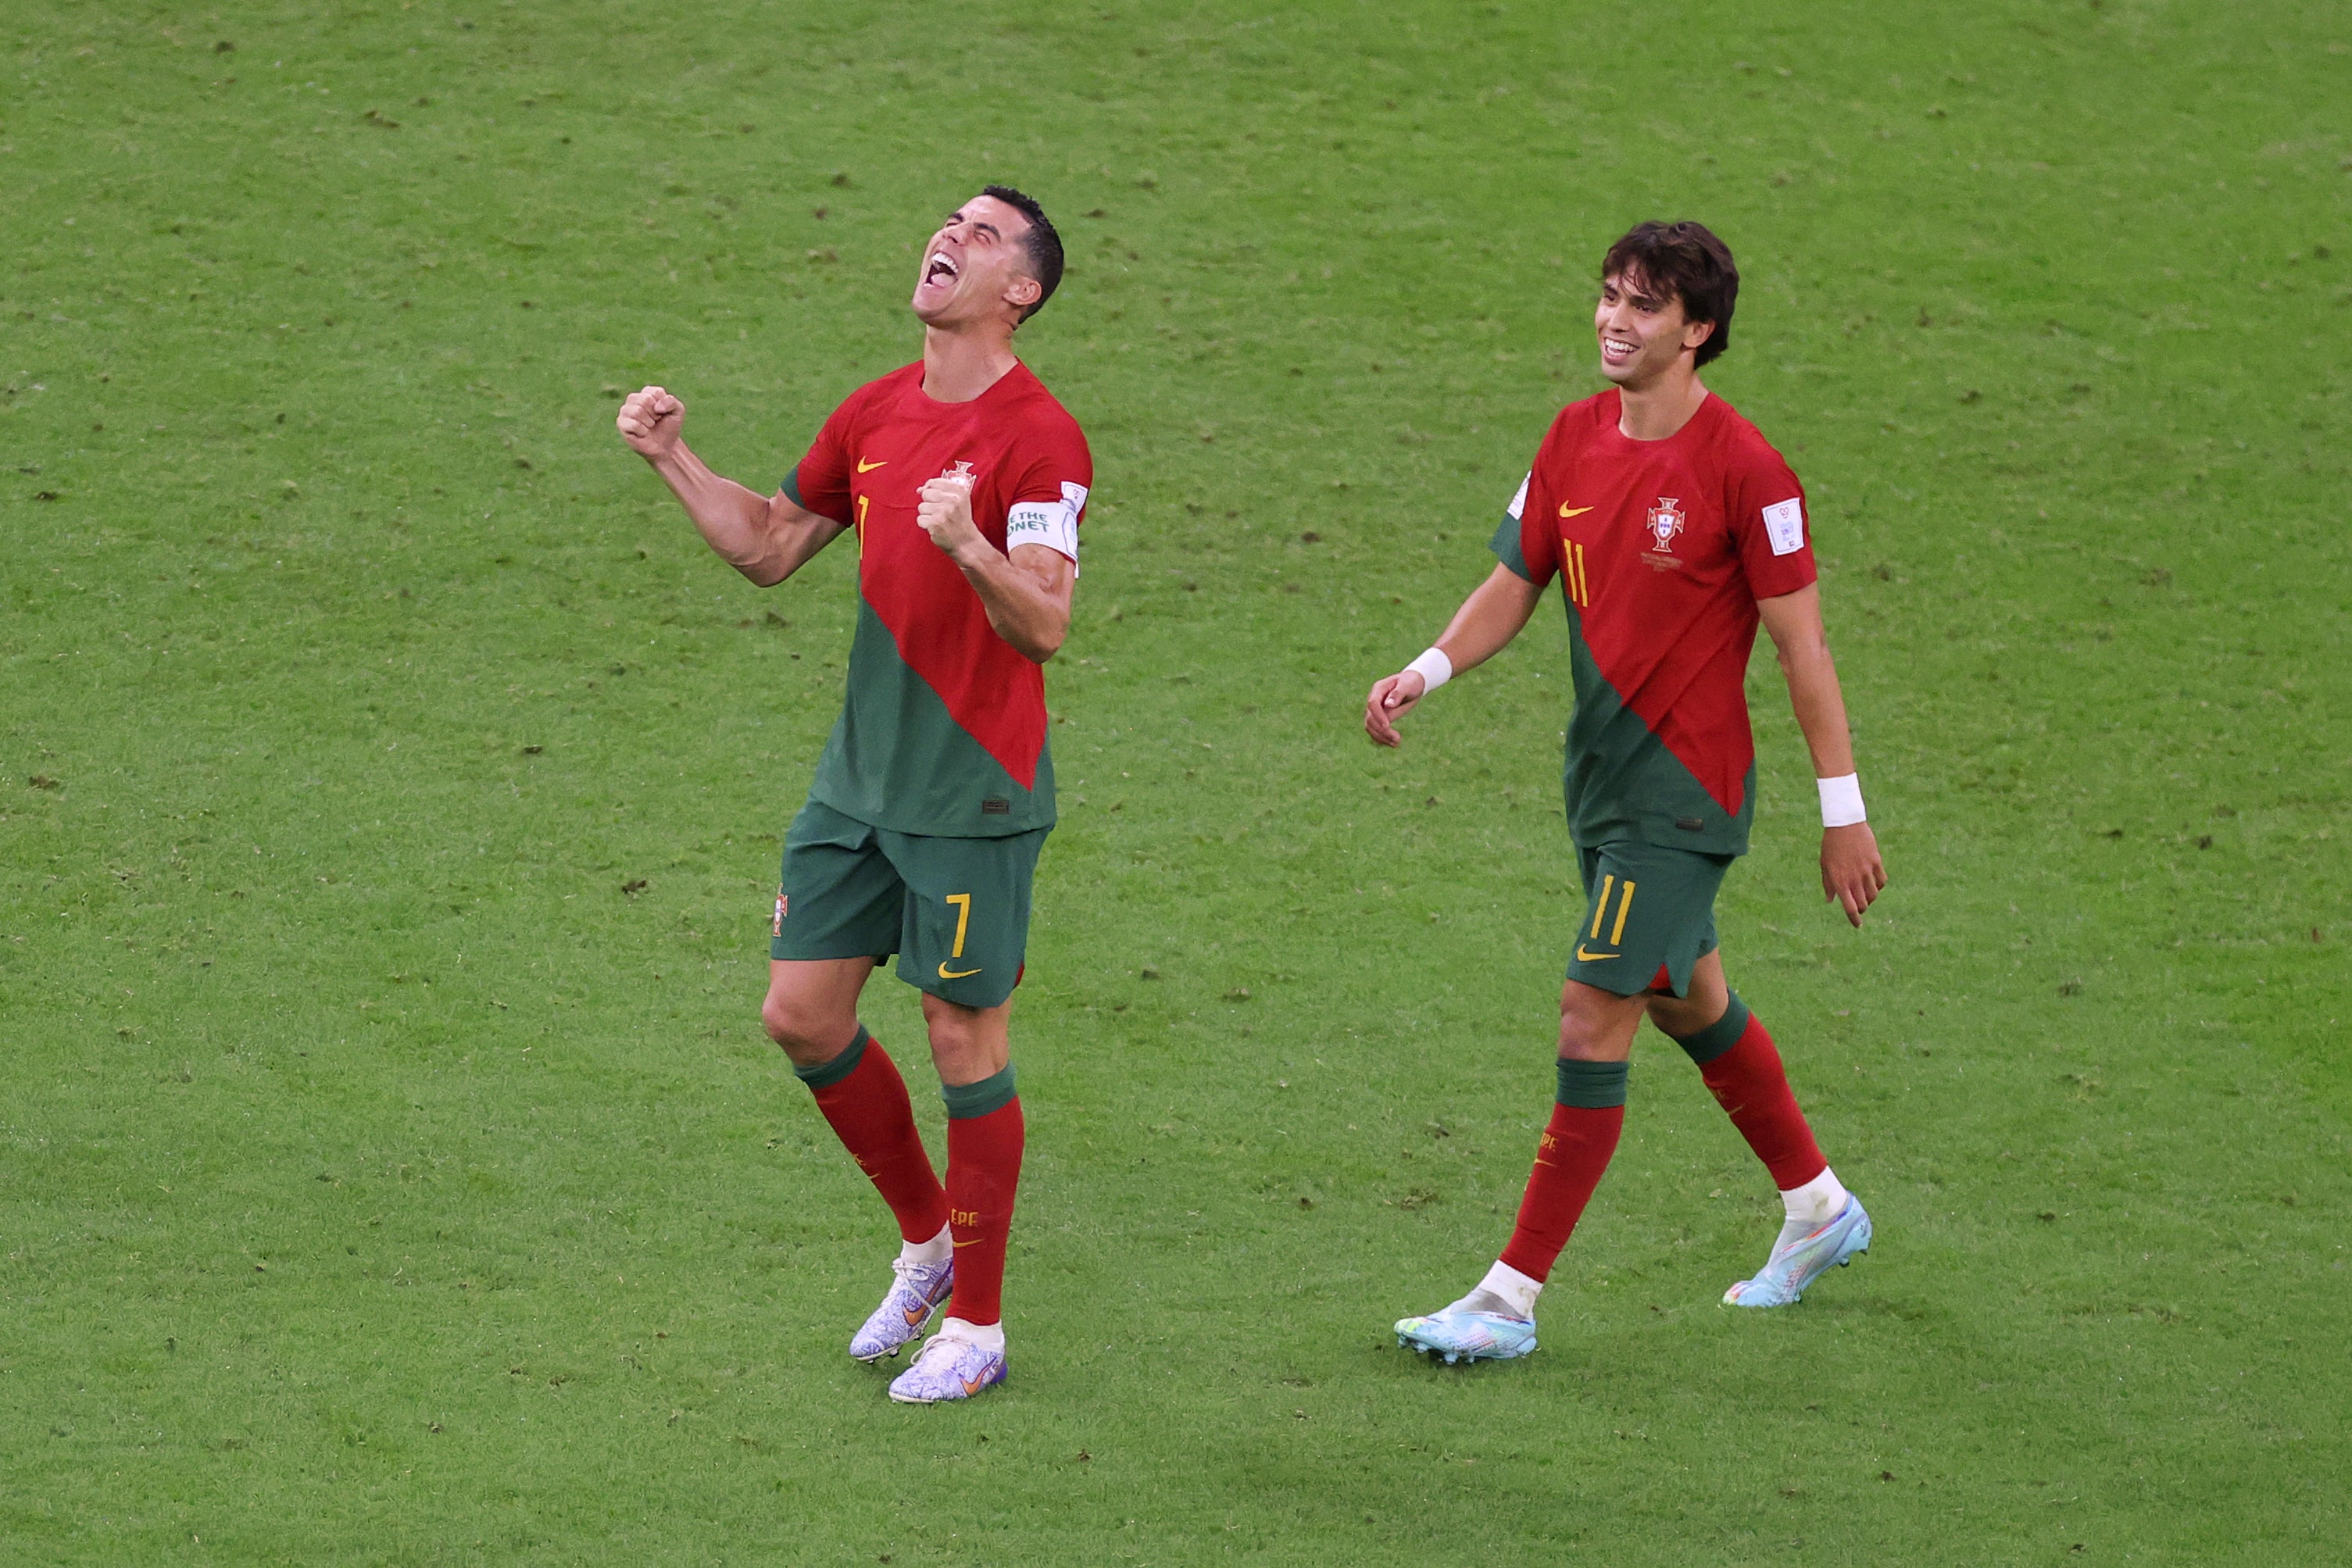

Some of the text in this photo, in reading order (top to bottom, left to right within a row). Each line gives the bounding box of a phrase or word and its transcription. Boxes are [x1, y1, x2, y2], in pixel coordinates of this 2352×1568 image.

[858, 495, 869, 559] 7
[1019, 512, 1047, 523] THE
[1564, 538, 1588, 608] 11
[946, 893, 970, 958] 7
[1590, 874, 1636, 945] 11
